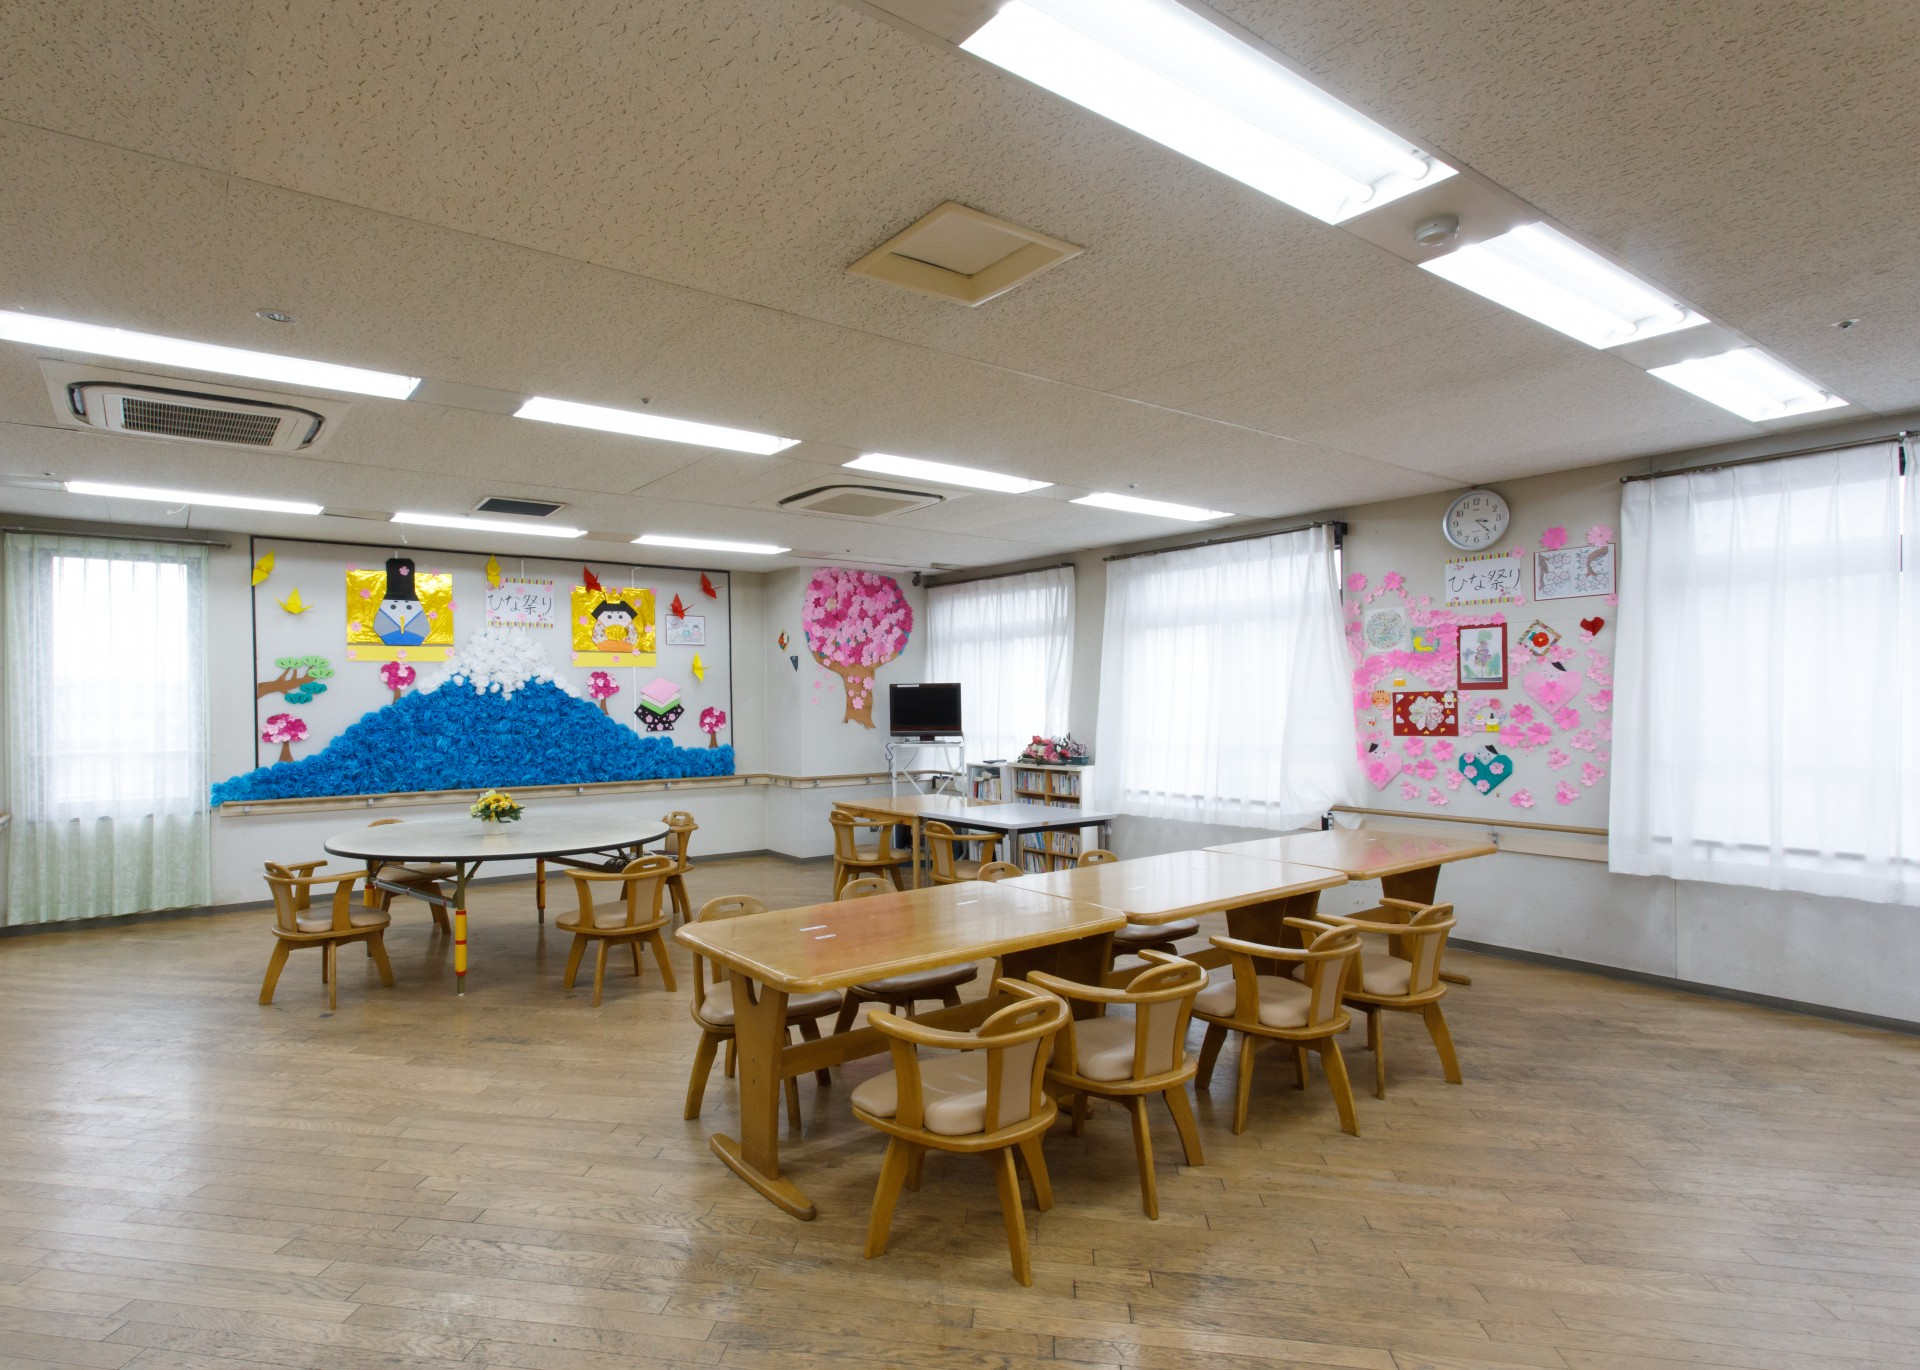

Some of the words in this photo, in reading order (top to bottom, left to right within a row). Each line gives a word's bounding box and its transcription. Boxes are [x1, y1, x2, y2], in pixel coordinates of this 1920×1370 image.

[1448, 568, 1521, 593] ひな祭り
[488, 594, 552, 616] ひな祭り
